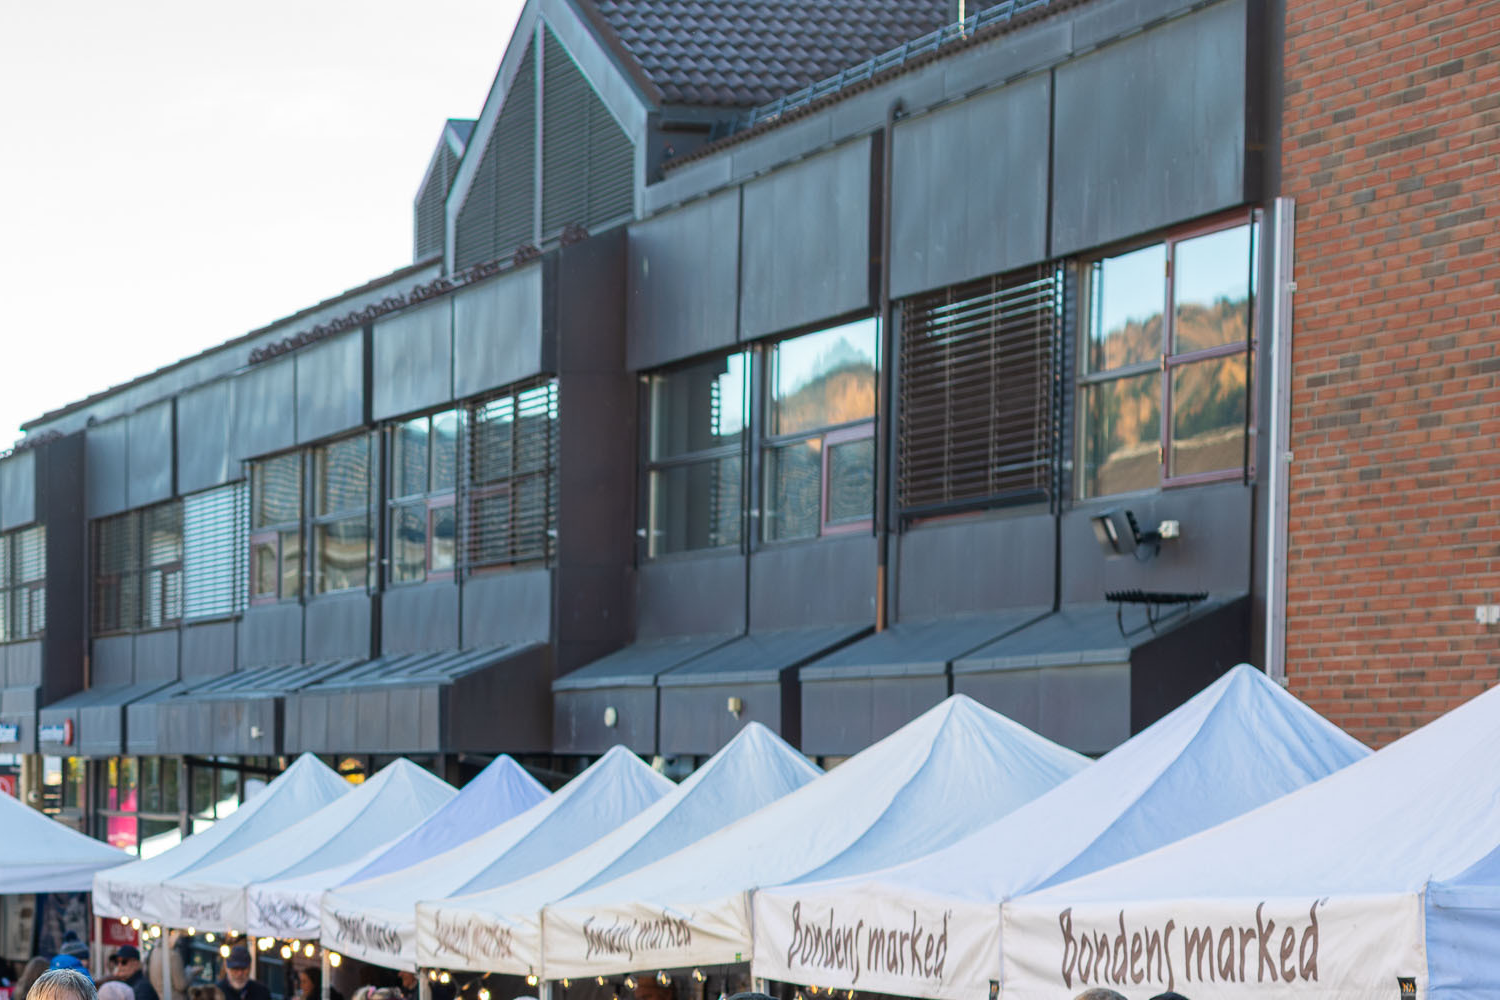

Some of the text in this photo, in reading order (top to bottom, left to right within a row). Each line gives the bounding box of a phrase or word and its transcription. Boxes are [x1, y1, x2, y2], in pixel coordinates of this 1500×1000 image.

[787, 901, 948, 984] Bondens marked
[1059, 899, 1319, 992] Bondens marked
